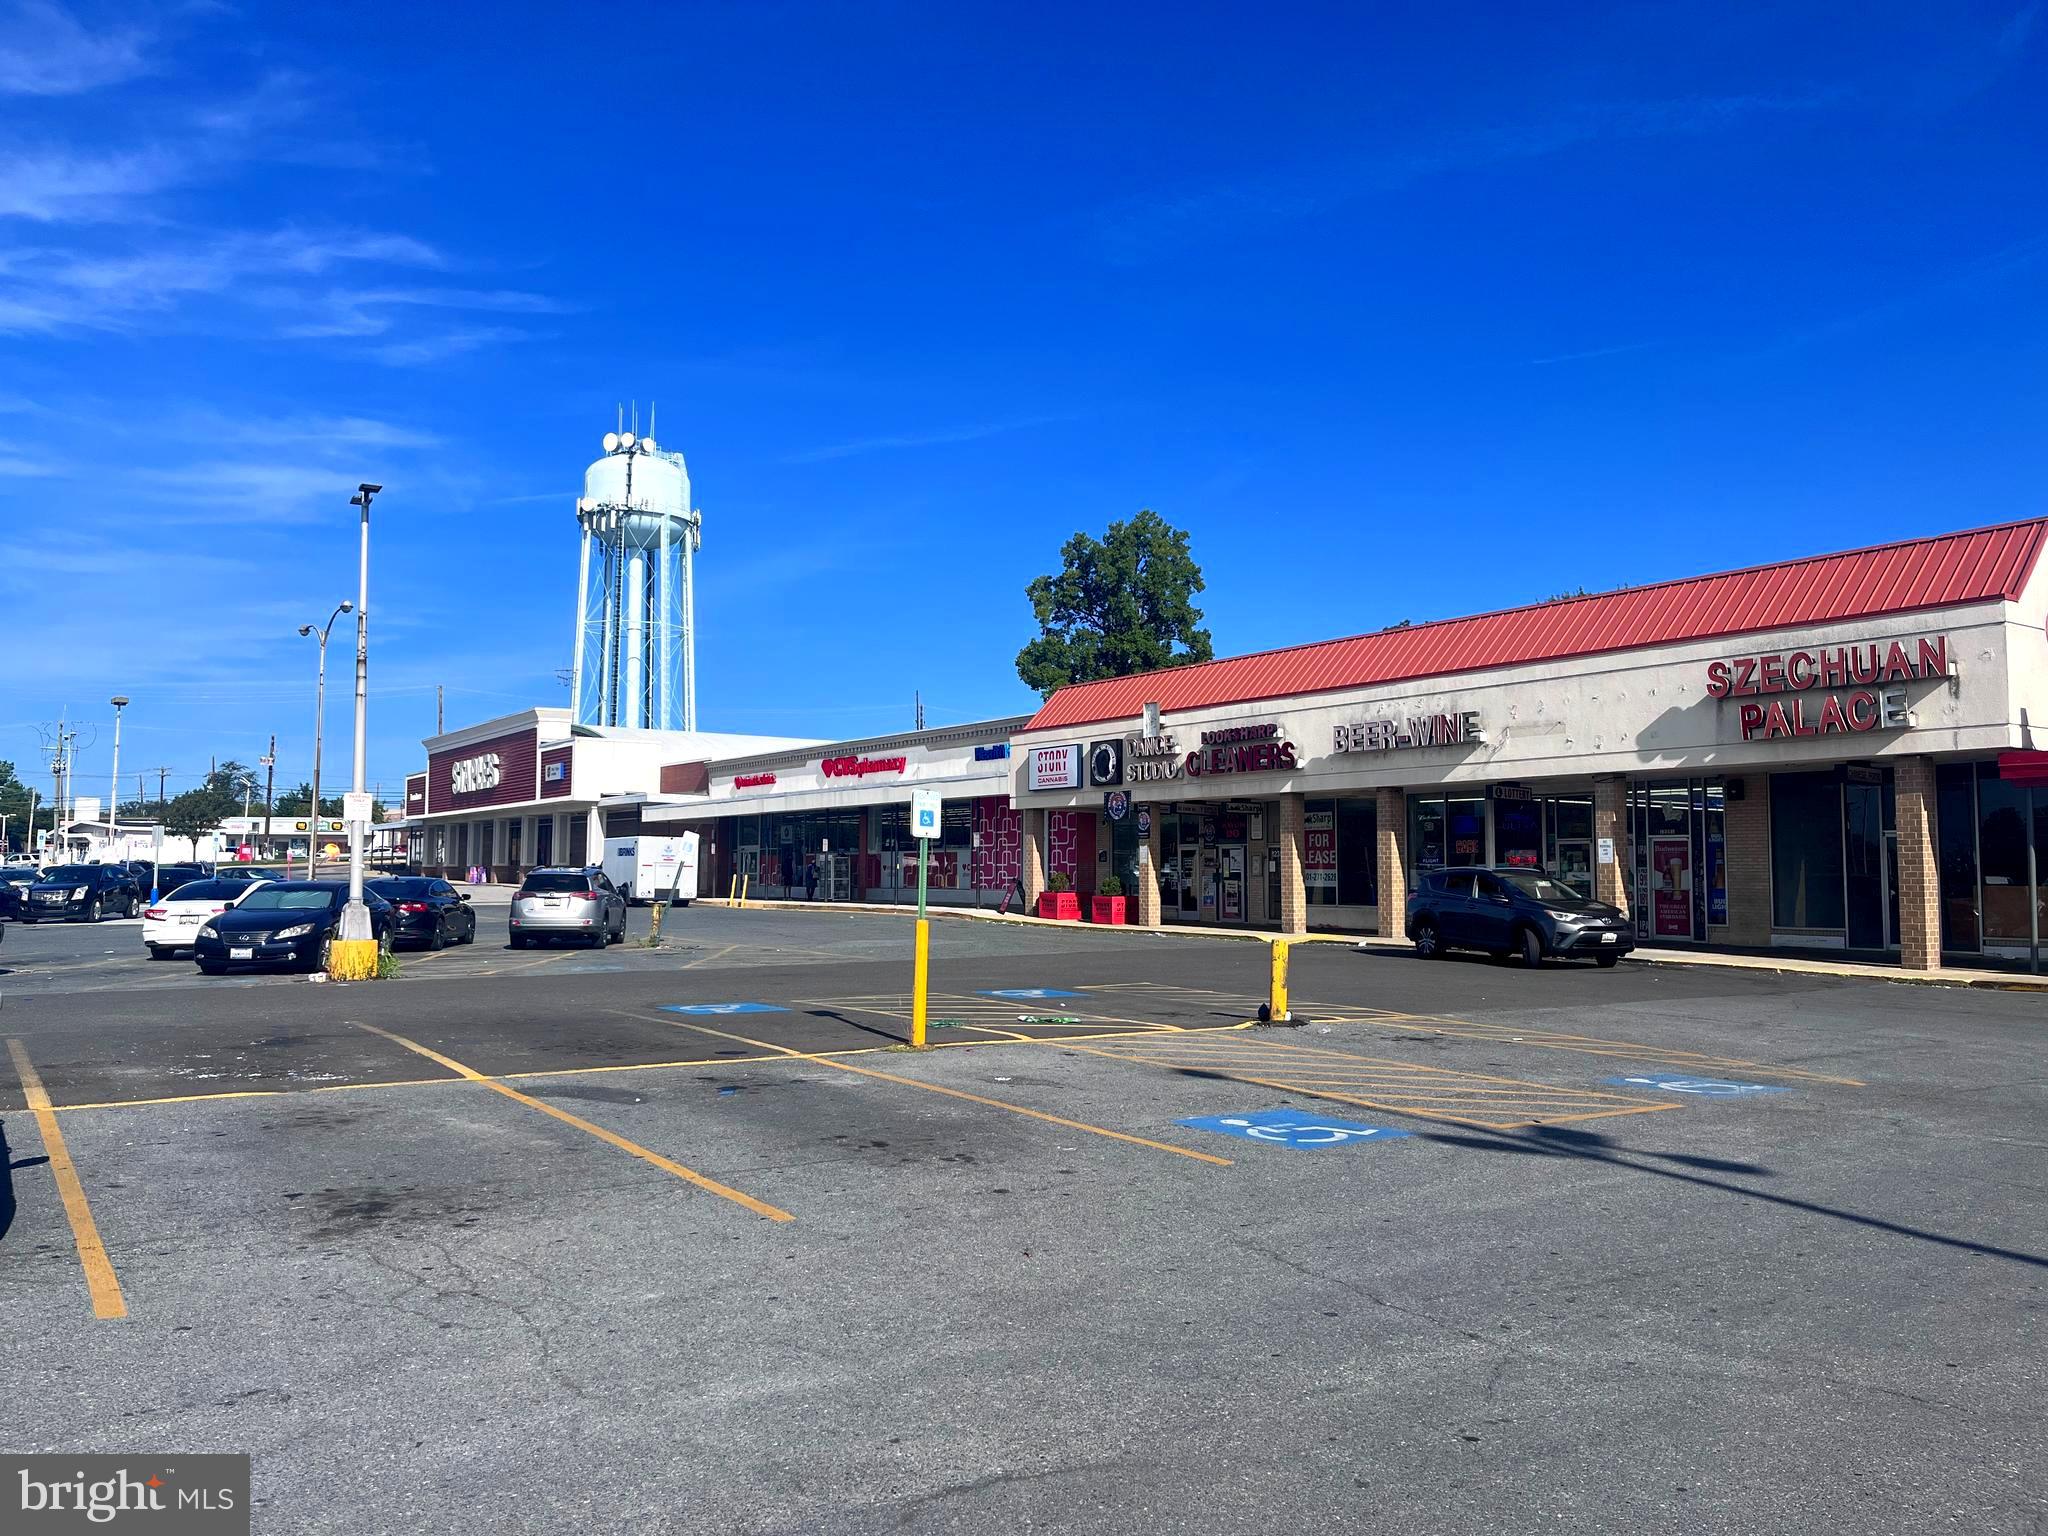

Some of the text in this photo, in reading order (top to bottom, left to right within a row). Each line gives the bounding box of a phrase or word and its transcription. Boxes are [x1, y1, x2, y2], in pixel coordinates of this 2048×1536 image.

[1706, 636, 1949, 699] SZECHUAN
[1739, 688, 1910, 740] PALACE
[1127, 737, 1176, 757] DANCE
[1186, 742, 1295, 777] CLEANERS
[1037, 776, 1069, 785] CANNABIS
[1126, 761, 1178, 782] STUDIO
[1503, 788, 1530, 800] LOTTERY
[1308, 834, 1330, 848] FOR
